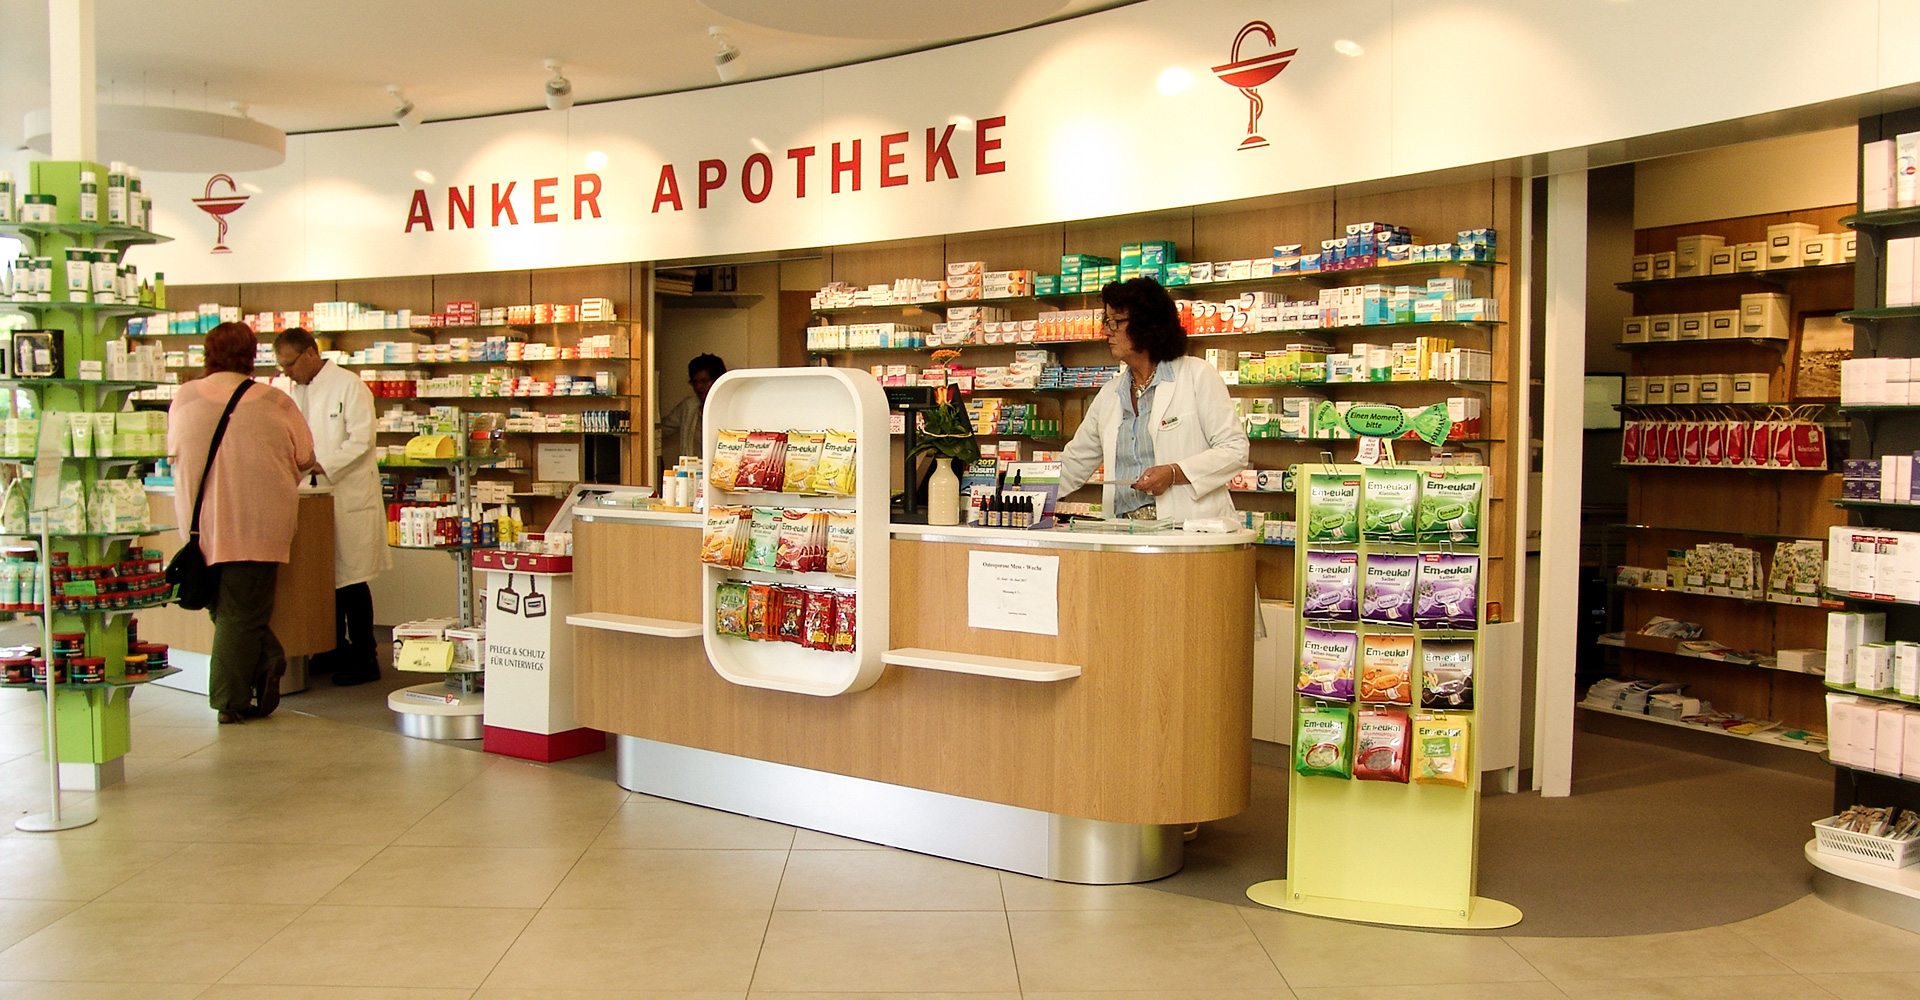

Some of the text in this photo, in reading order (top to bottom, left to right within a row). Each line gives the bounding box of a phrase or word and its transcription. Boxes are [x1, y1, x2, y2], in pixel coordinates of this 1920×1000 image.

[405, 115, 1006, 233] ANKER APOTHEKE
[1350, 411, 1399, 422] Einen Moment
[1365, 421, 1382, 429] bitte
[786, 444, 817, 454] Em-eukal
[824, 442, 853, 453] Em-eukal
[969, 465, 996, 474] Büsum
[1367, 481, 1412, 491] Em-eukal
[1427, 481, 1476, 491] Em-eukal
[1311, 488, 1354, 497] Em-eukal
[781, 522, 808, 533] Em-eukal
[1308, 564, 1351, 574] Em-eukal
[1367, 567, 1411, 577] Em-eukal
[1423, 565, 1473, 575] Em-eukal
[489, 644, 546, 659] PFLEGE & SCHUTZ
[1304, 641, 1348, 653] Em-eukal
[1366, 647, 1409, 657] Em-eukal
[1425, 652, 1470, 662] Em-eukal
[490, 656, 544, 671] FÜR UNTERWEGS
